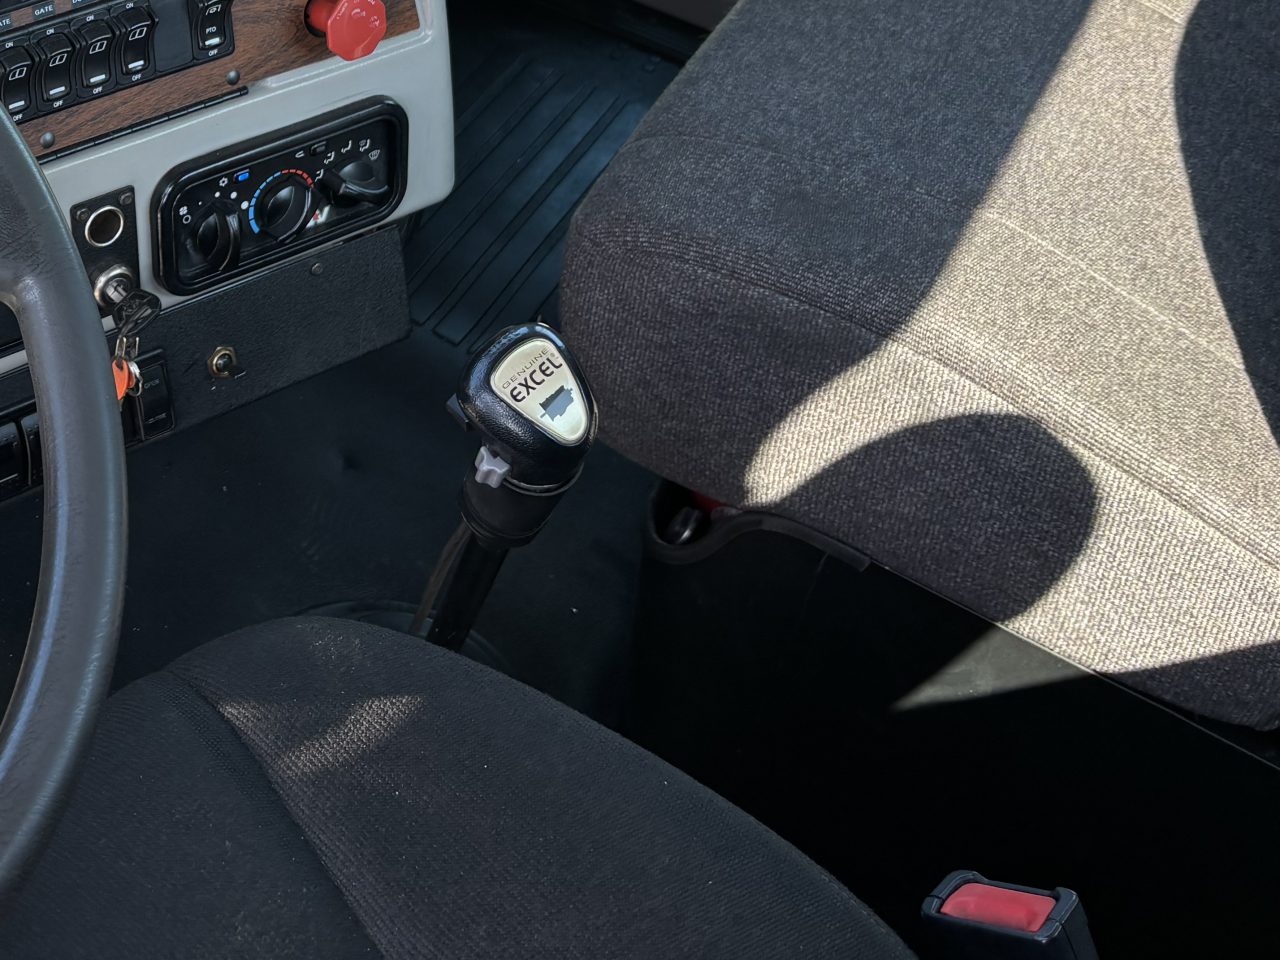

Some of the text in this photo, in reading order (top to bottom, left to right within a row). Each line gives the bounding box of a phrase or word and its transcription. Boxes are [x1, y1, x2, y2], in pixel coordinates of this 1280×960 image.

[34, 4, 54, 16] GATE
[205, 26, 217, 34] PTO
[93, 86, 103, 94] OFF
[53, 100, 63, 108] OFF
[12, 113, 23, 121] OFF
[502, 347, 550, 390] GENUINE
[509, 357, 563, 403] EXCEL
